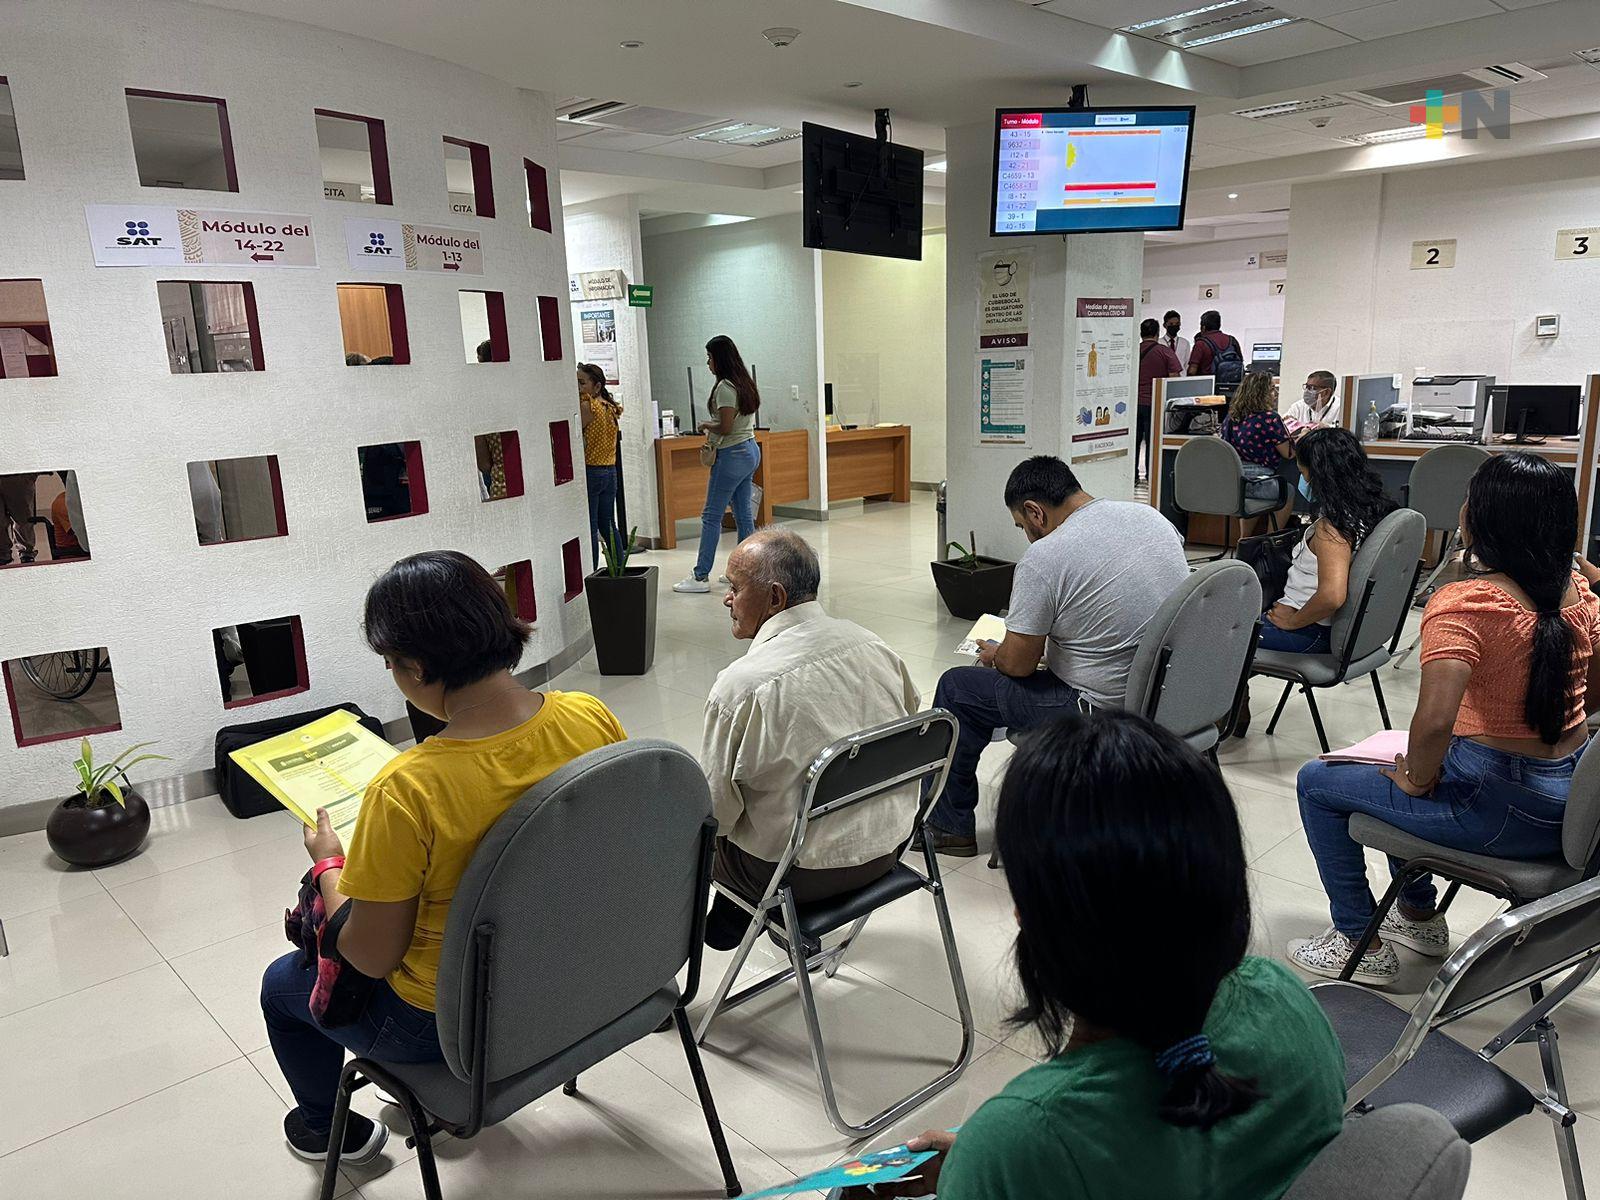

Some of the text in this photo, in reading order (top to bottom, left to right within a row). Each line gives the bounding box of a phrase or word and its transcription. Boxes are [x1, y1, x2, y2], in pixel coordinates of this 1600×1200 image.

[453, 204, 472, 213] CITA
[202, 220, 310, 236] Módulo del
[116, 236, 162, 246] SAT
[235, 239, 285, 252] 14-22
[416, 234, 480, 250] Módulo del
[1572, 236, 1589, 254] 3
[364, 246, 392, 254] SAT
[442, 251, 462, 262] 1-13
[1426, 248, 1440, 264] 2
[1206, 288, 1213, 298] 6
[1276, 284, 1284, 294] 7
[584, 312, 610, 320] IMPORTANTE
